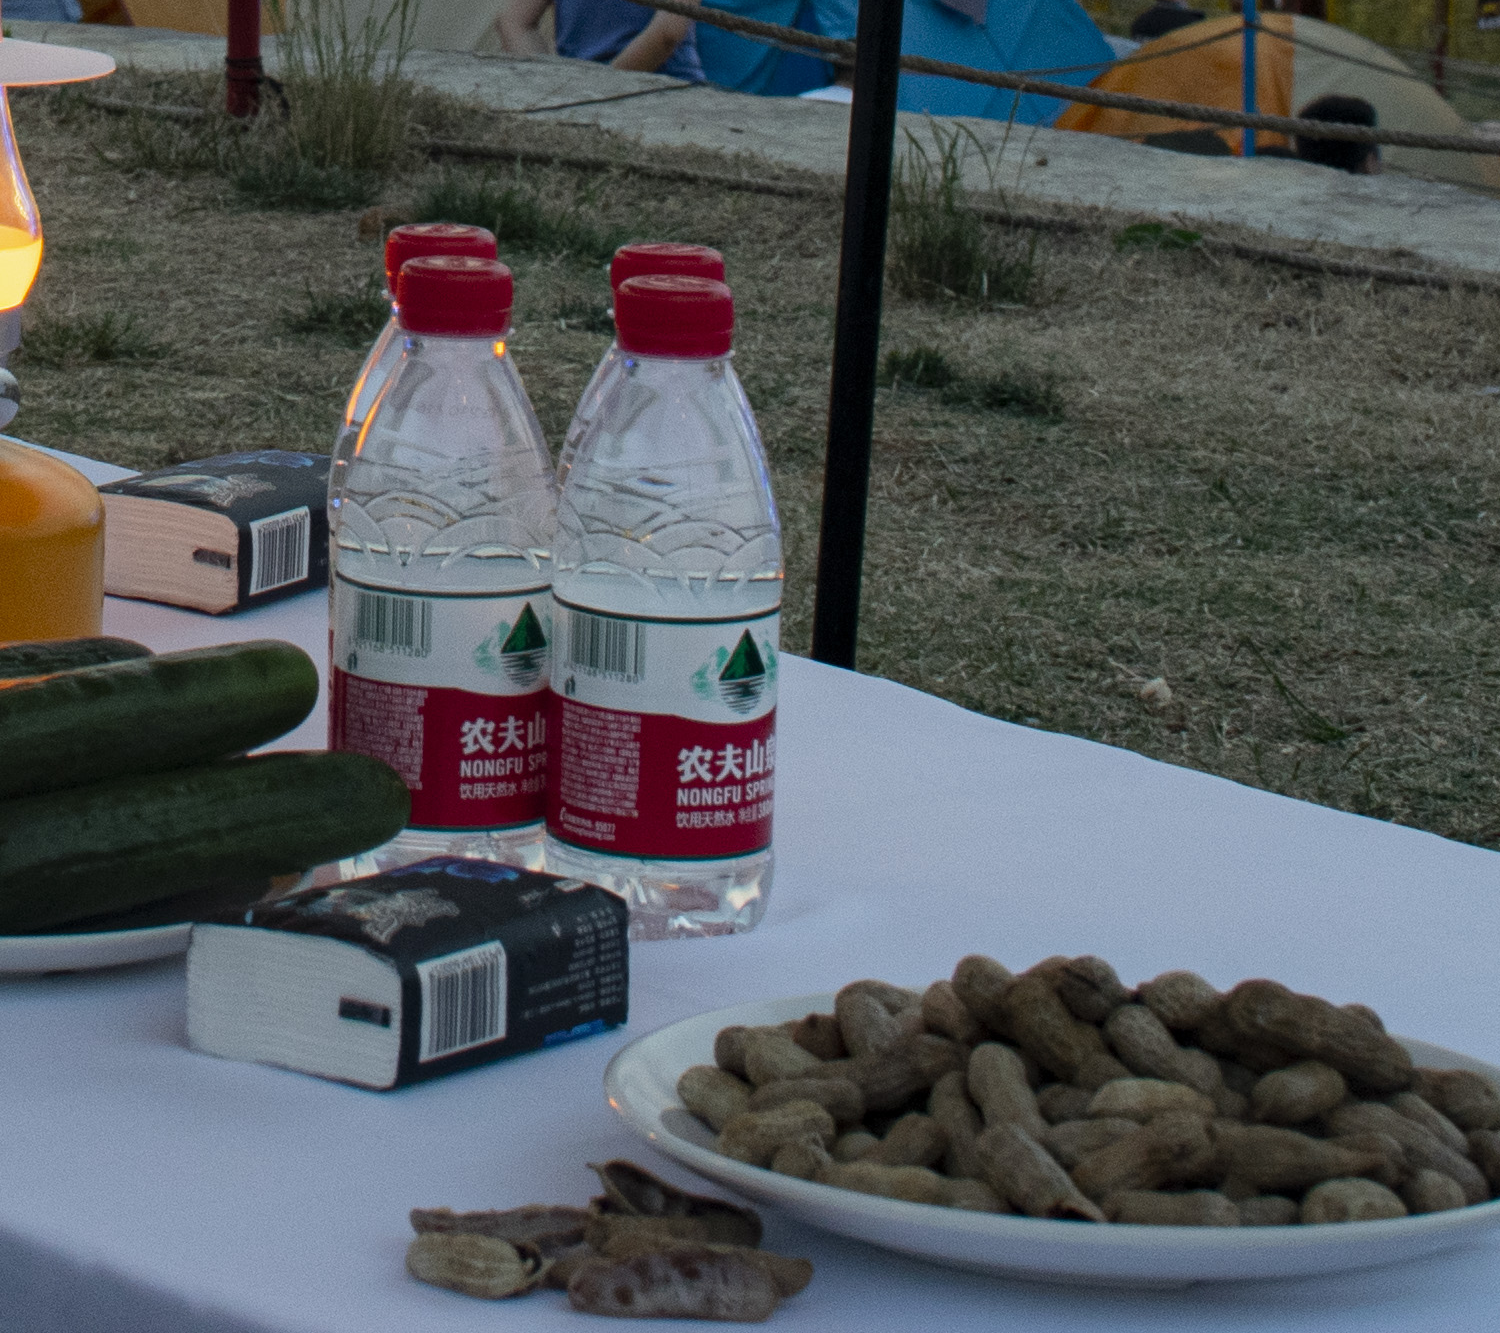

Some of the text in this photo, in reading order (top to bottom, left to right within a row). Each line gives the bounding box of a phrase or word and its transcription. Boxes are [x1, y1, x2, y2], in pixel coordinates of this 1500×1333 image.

[459, 756, 524, 778] NONGFU
[459, 780, 518, 800] 饮用天然水
[676, 784, 741, 807] NONGFU
[675, 809, 736, 828] 饮用天然水
